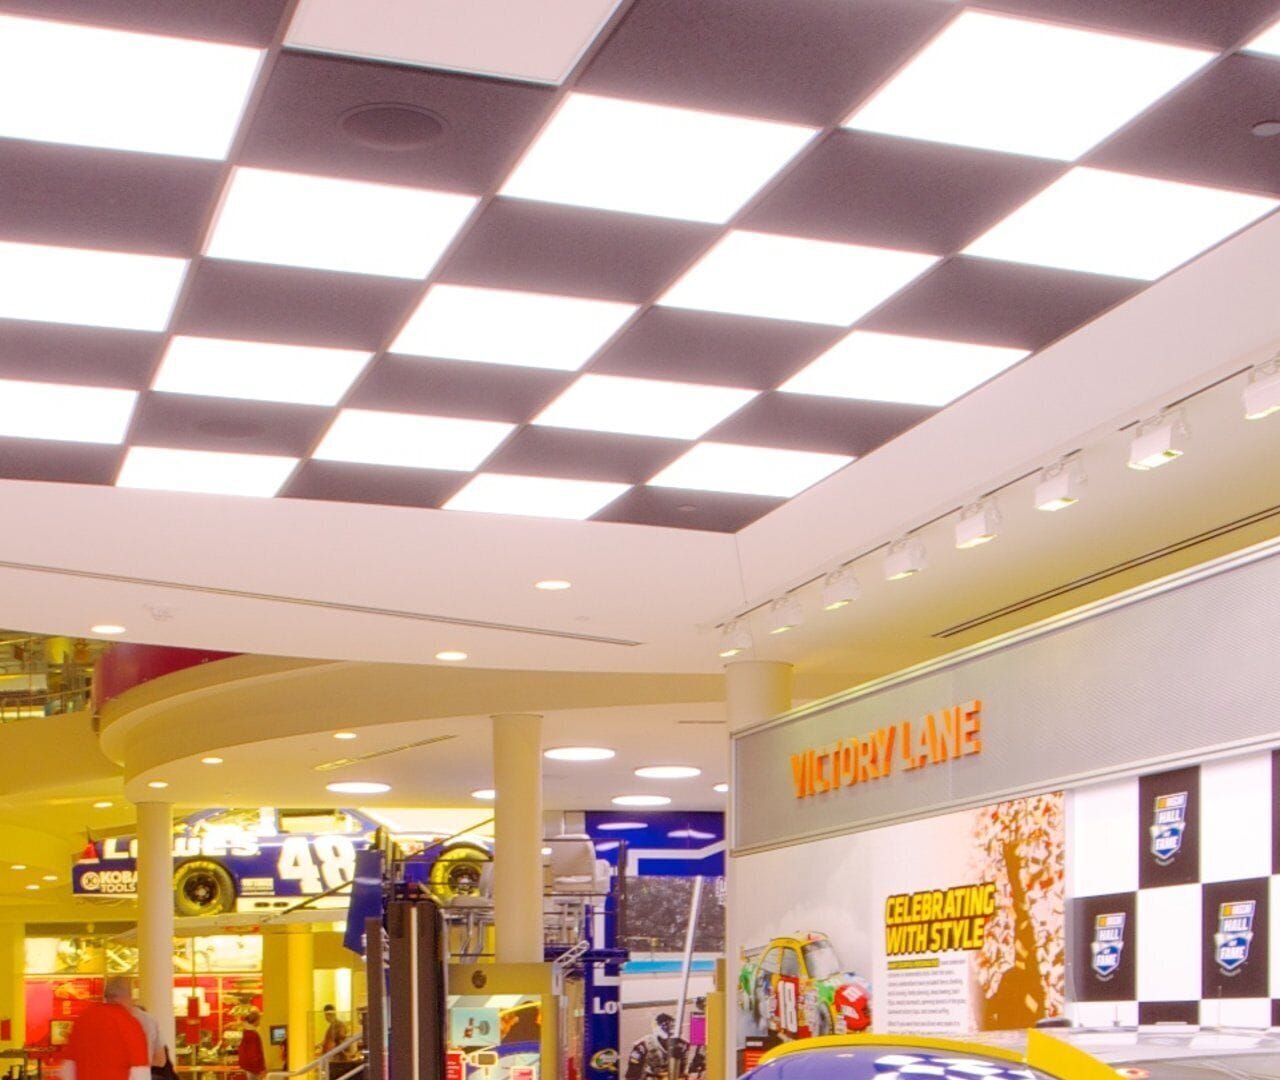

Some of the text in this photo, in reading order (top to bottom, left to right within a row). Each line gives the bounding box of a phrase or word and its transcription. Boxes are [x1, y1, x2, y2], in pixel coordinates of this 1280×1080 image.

[790, 700, 982, 799] VICTORY LANE
[277, 837, 356, 893] 48
[886, 883, 995, 924] CELEBRATING
[886, 917, 985, 955] WITH STYLE
